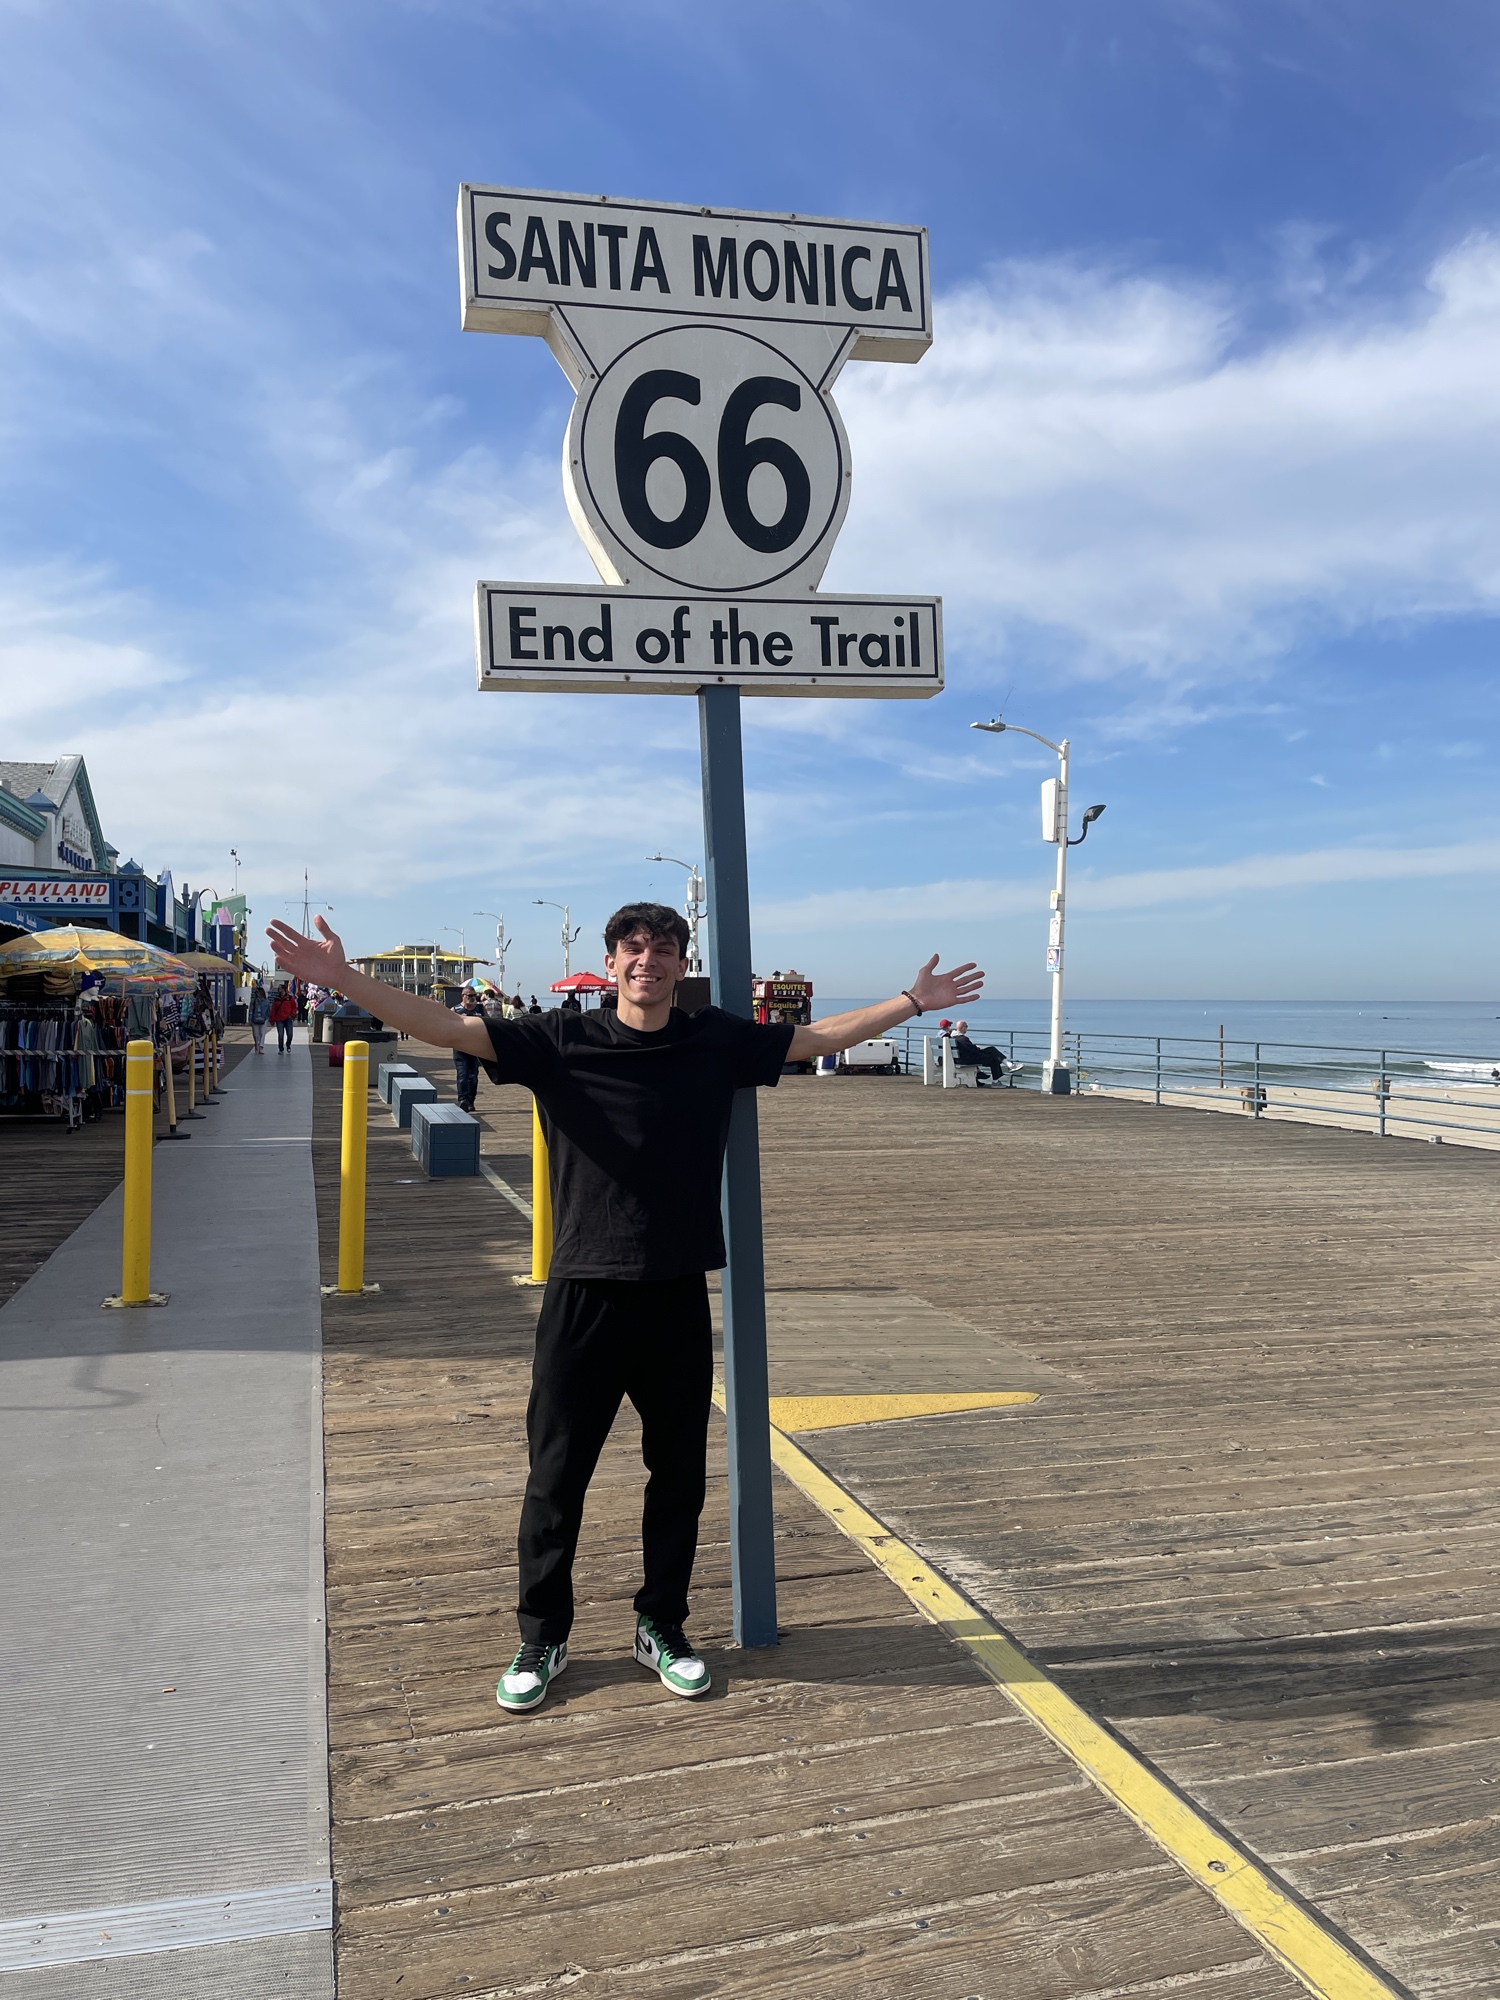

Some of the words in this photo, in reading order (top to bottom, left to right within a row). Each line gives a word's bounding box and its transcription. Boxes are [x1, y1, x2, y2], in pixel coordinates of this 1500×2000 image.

[484, 211, 671, 294] SANTA
[692, 235, 913, 312] MONICA
[614, 369, 811, 553] 66
[509, 604, 614, 662] End
[635, 606, 691, 664] of
[710, 607, 793, 666] the
[811, 611, 920, 668] Trail
[0, 882, 107, 896] PLAYLAND
